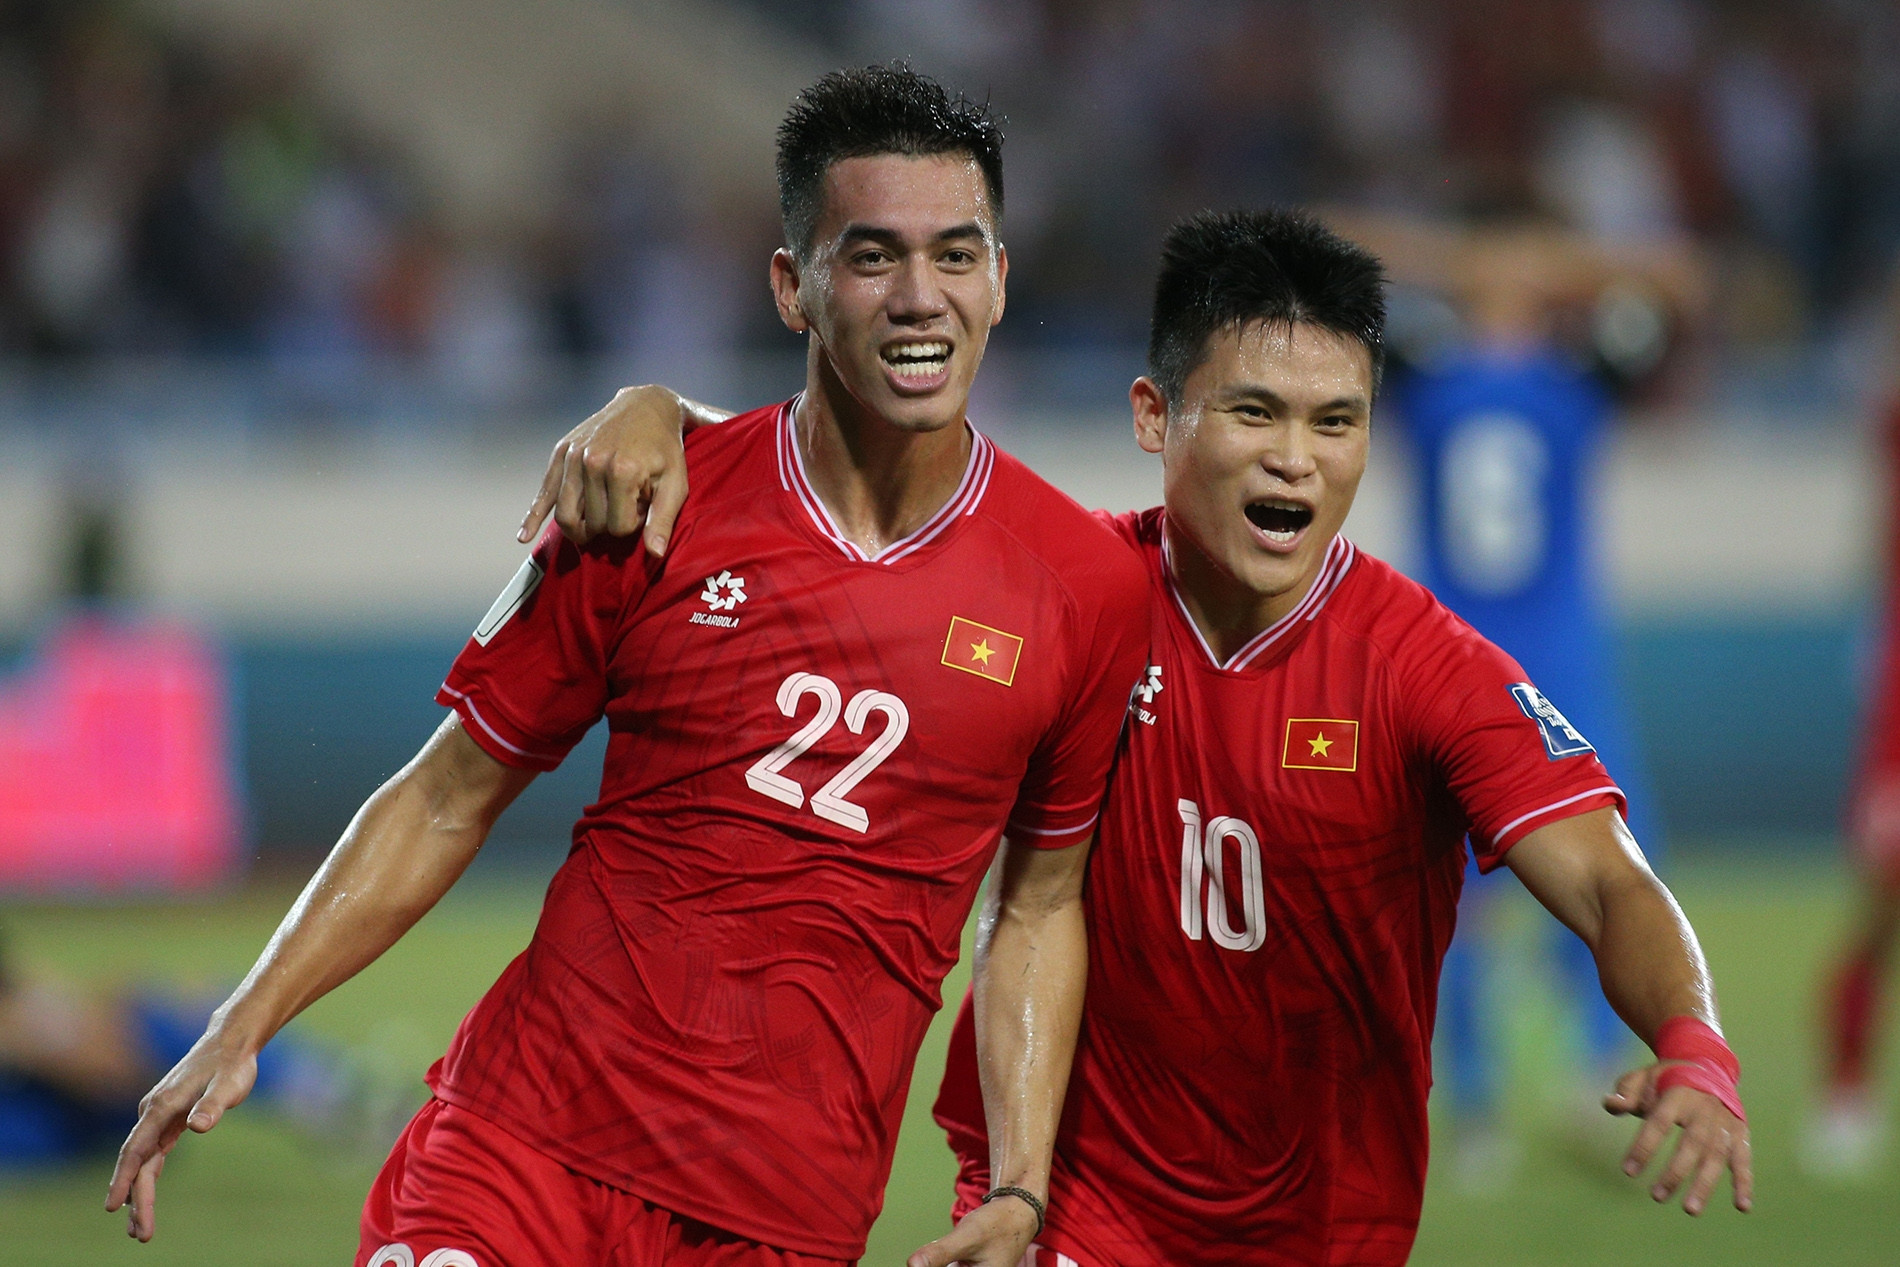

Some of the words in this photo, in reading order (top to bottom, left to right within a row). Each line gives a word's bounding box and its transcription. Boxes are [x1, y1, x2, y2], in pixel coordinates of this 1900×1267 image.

[688, 611, 740, 628] JOGARBOLA
[744, 671, 910, 834] 22
[1177, 798, 1267, 952] 10
